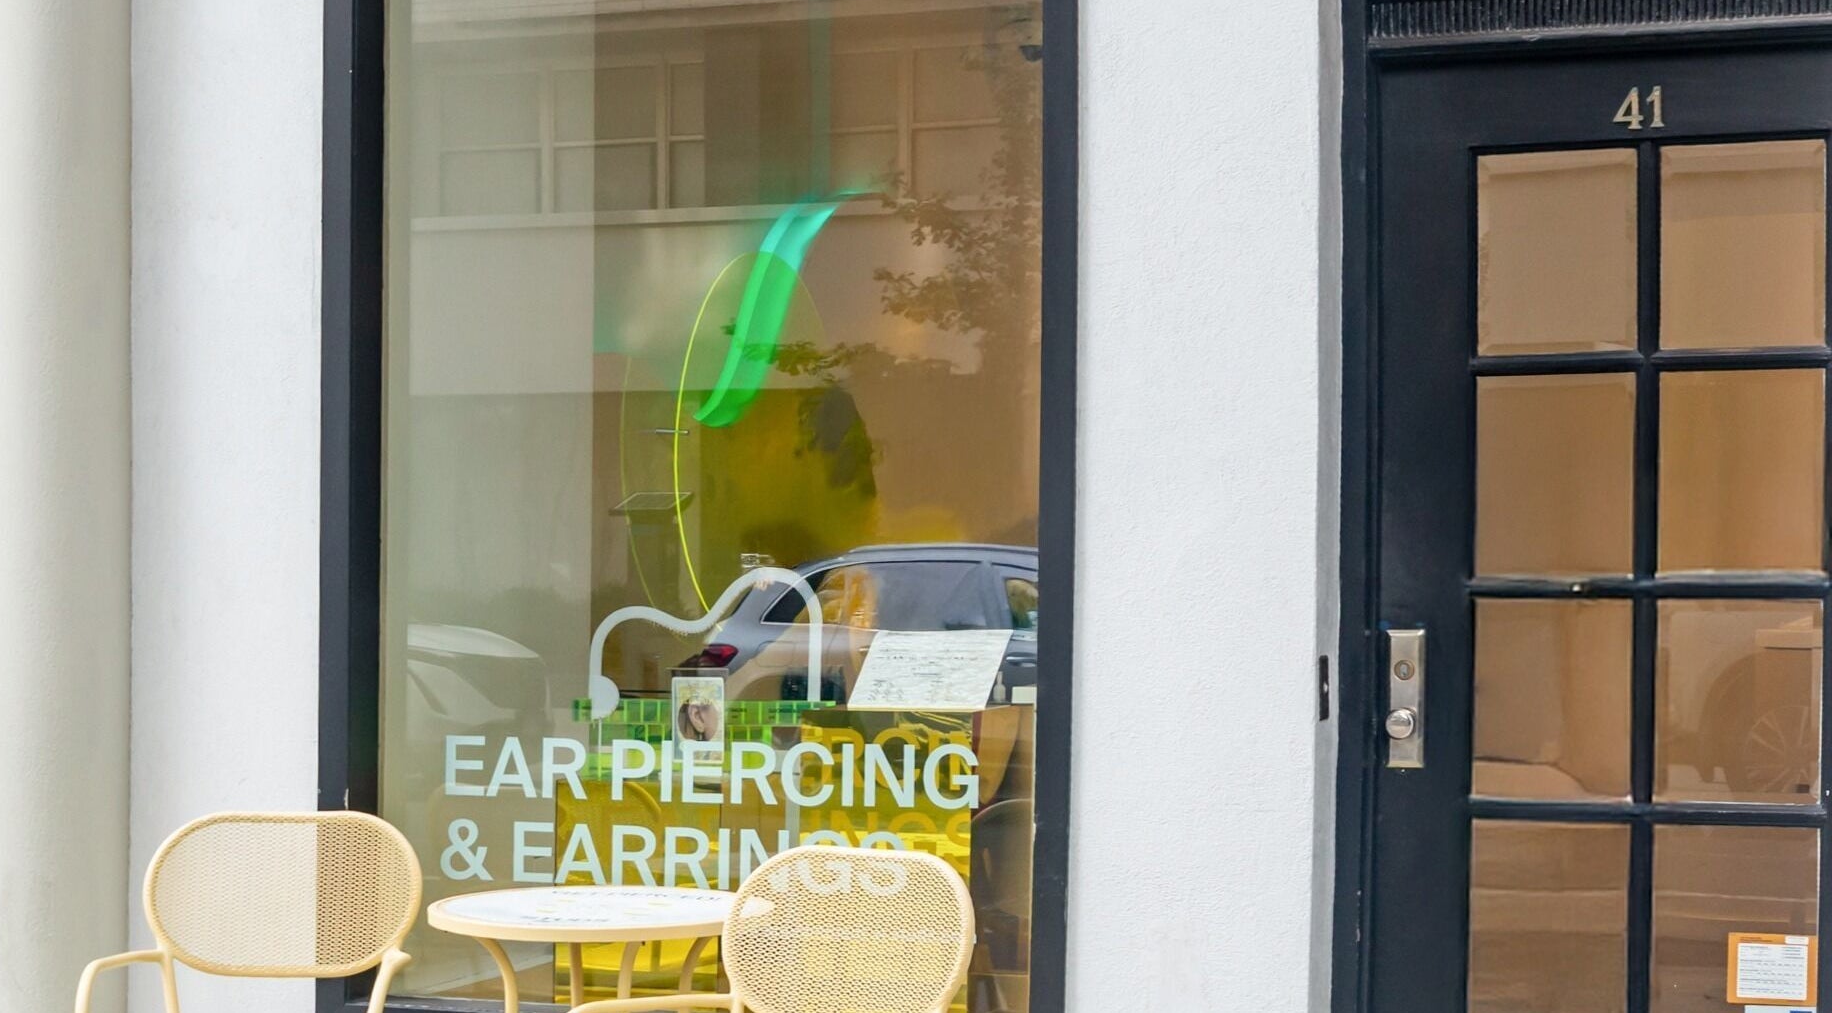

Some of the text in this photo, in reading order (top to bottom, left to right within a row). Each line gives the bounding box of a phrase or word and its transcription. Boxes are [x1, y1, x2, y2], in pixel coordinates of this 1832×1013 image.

[1612, 85, 1665, 130] 41
[444, 735, 979, 810] EAR PIERCING
[440, 818, 493, 882] &
